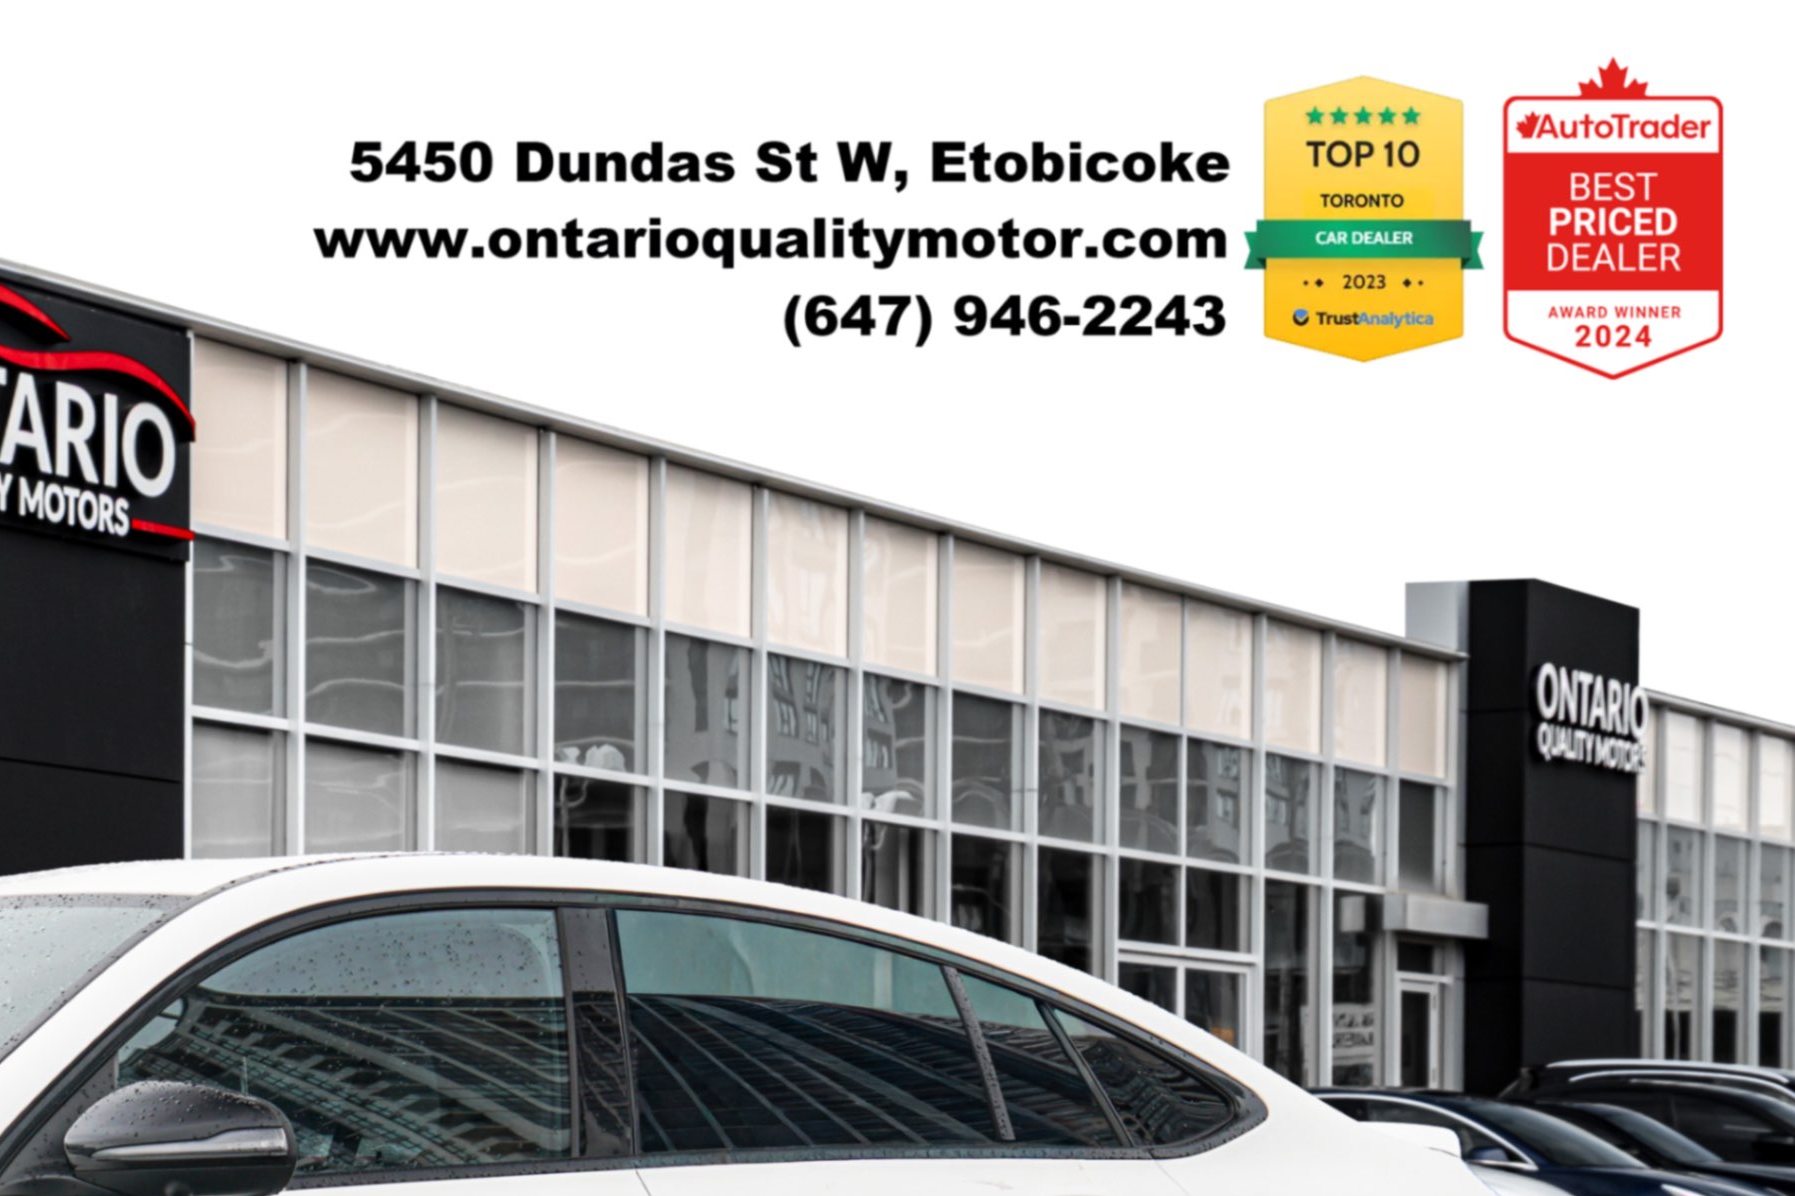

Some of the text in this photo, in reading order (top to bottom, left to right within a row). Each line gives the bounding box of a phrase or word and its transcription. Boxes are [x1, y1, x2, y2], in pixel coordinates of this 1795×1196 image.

[18, 477, 131, 536] MOTORS
[1536, 661, 1649, 740] ONTARIO
[1537, 721, 1595, 764] QUALITY
